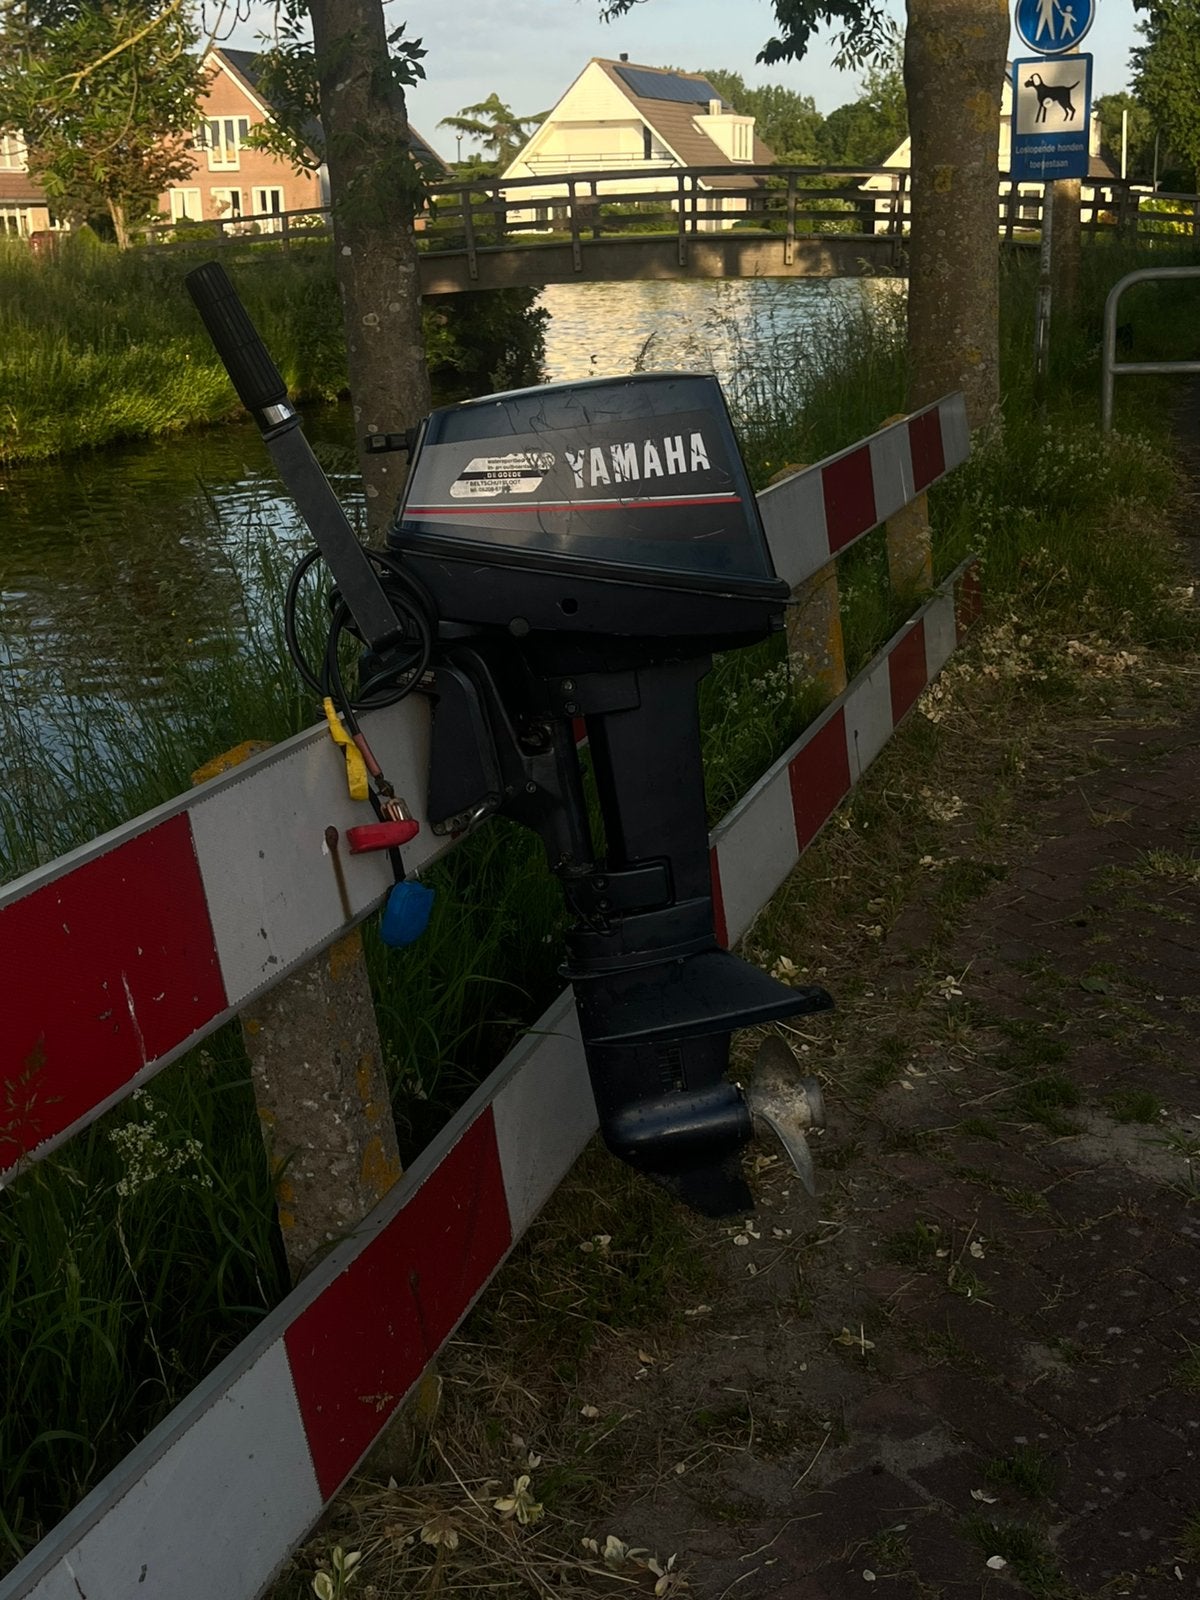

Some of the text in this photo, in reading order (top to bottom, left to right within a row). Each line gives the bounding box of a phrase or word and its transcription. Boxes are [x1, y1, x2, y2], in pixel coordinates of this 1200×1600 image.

[1015, 143, 1084, 154] Loslopende honden
[564, 432, 711, 489] YAMAHA
